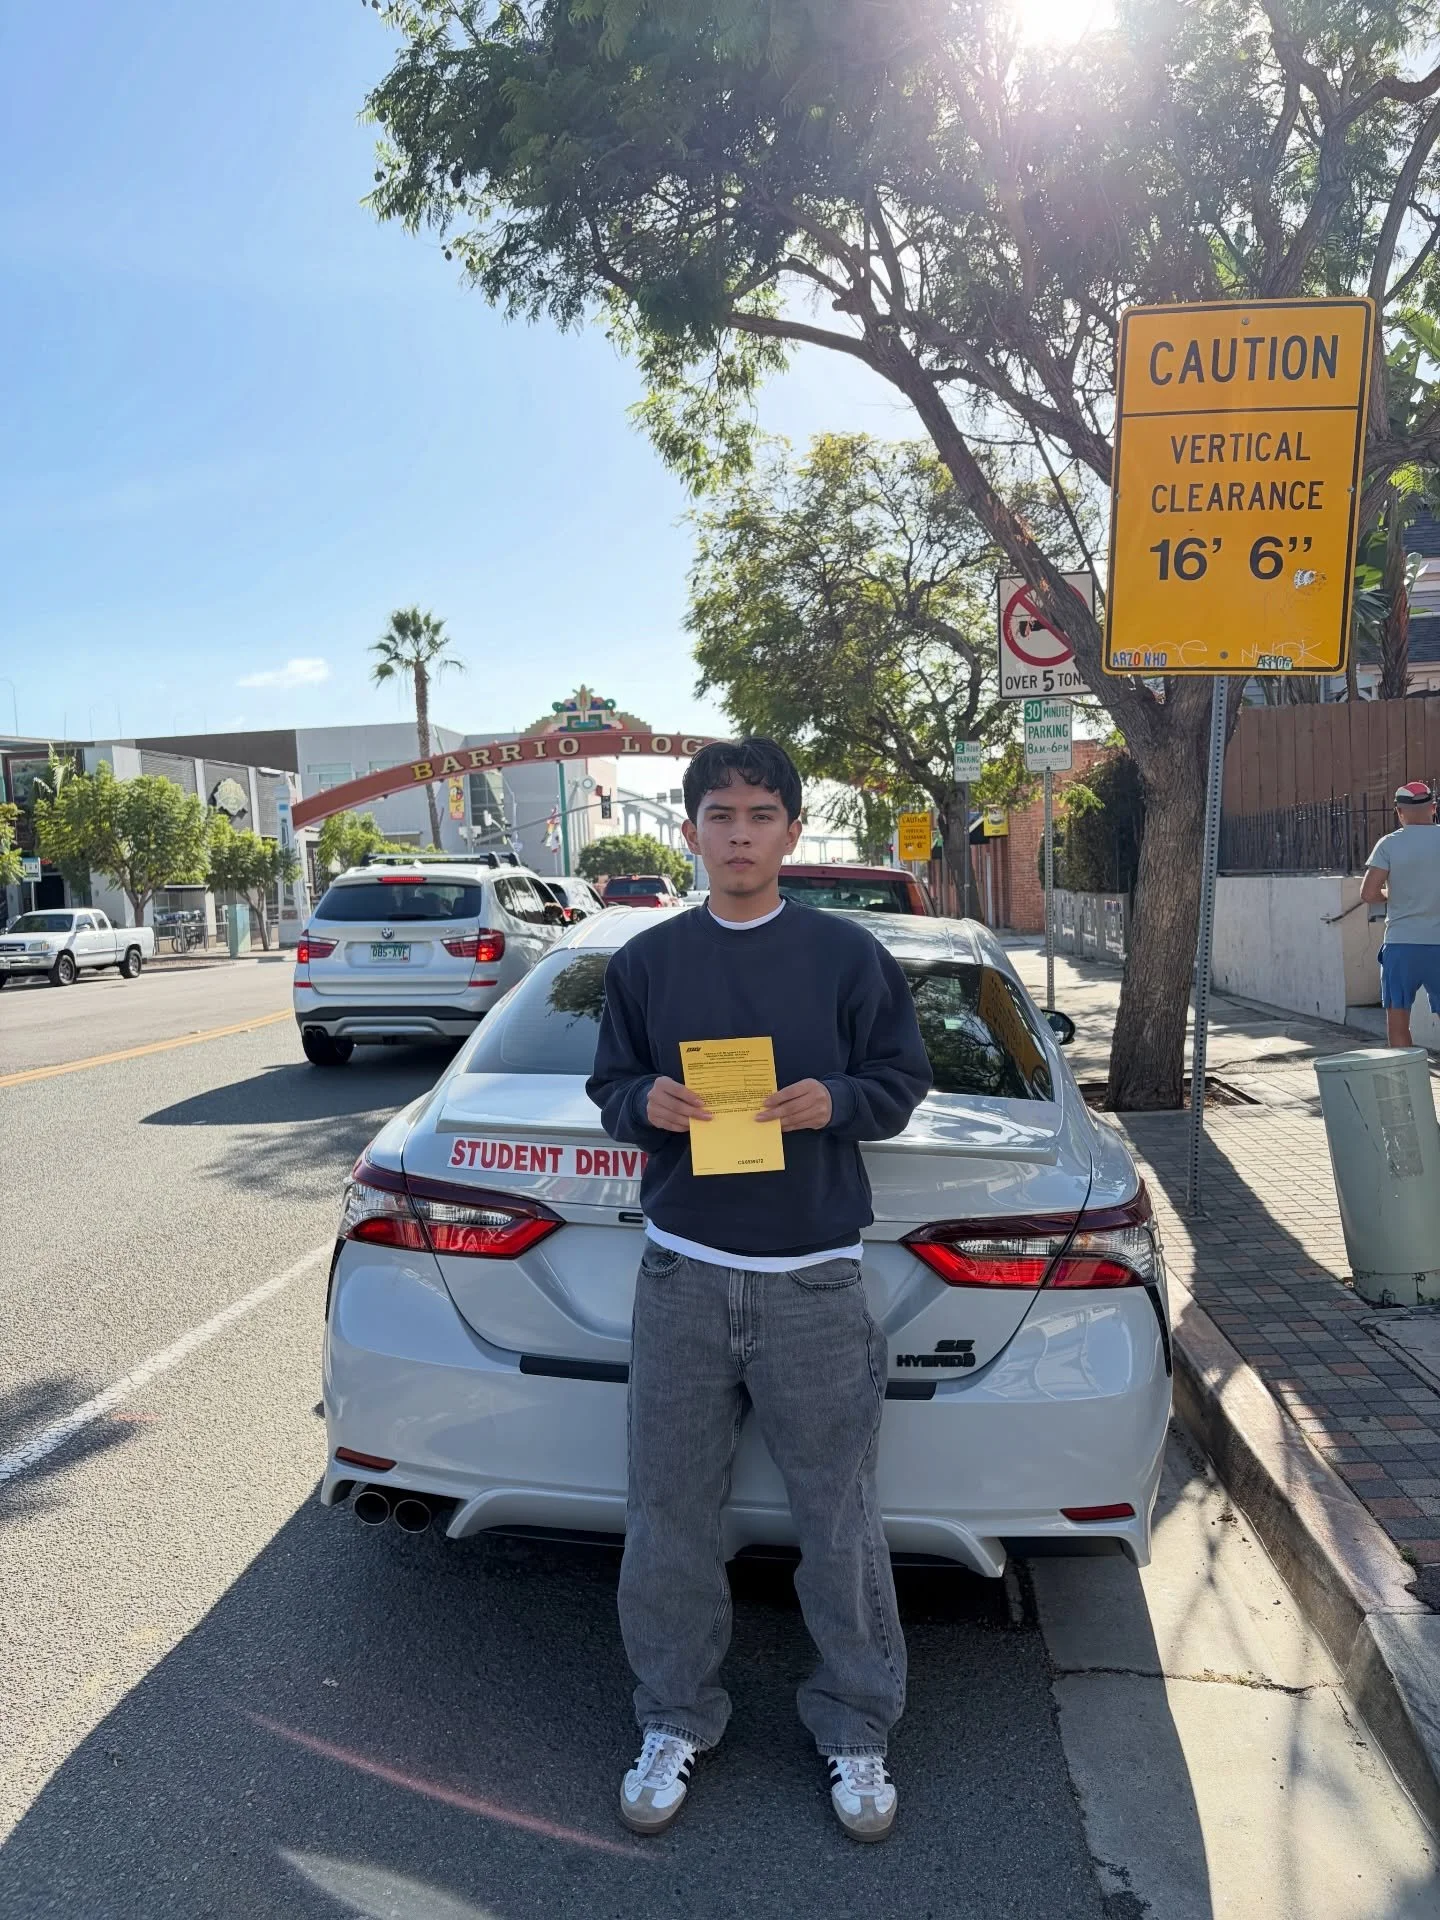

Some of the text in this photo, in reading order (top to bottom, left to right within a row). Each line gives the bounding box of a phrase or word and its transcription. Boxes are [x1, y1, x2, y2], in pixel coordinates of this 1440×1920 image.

[1149, 335, 1339, 386] CAUTION
[1170, 432, 1311, 464] VERTICAL
[1151, 481, 1324, 514] CLEARANCE
[1149, 537, 1222, 581] 16'
[1005, 669, 1085, 692] OVER 5 TON
[1025, 703, 1070, 720] 30 MINUTE
[1028, 724, 1069, 739] PARKING
[411, 736, 703, 781] BARRIO LOG
[956, 743, 964, 753] 2
[956, 755, 979, 764] PARKING
[451, 1139, 649, 1177] STUDENT DRIV
[896, 1354, 964, 1367] HYBRID
